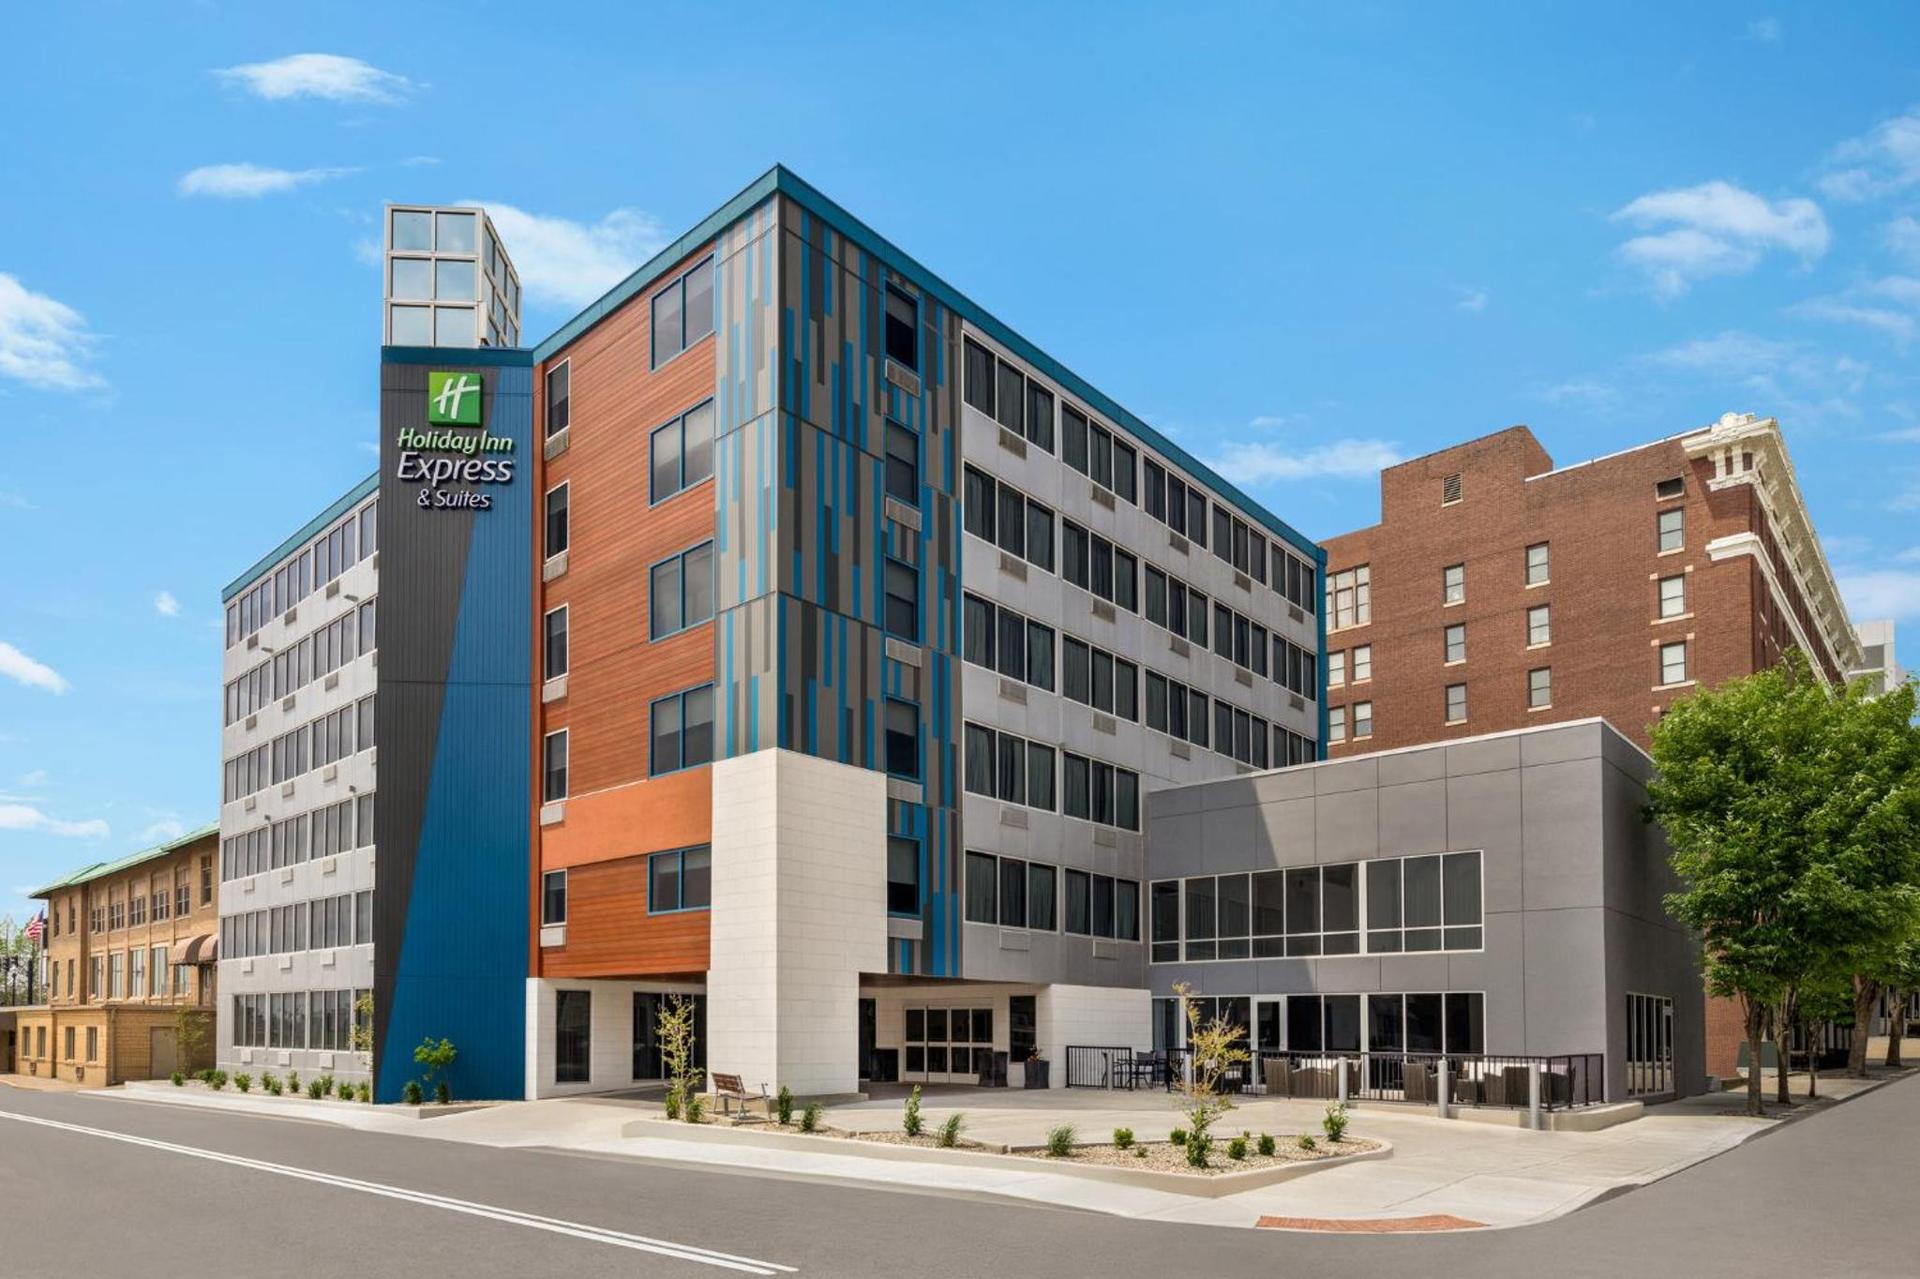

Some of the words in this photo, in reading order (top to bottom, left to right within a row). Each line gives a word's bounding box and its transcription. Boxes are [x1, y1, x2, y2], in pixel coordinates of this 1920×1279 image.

[398, 427, 477, 454] Holiday
[480, 430, 513, 450] Inn
[397, 451, 513, 487] Express
[417, 488, 430, 506] &
[434, 489, 491, 508] Suites
